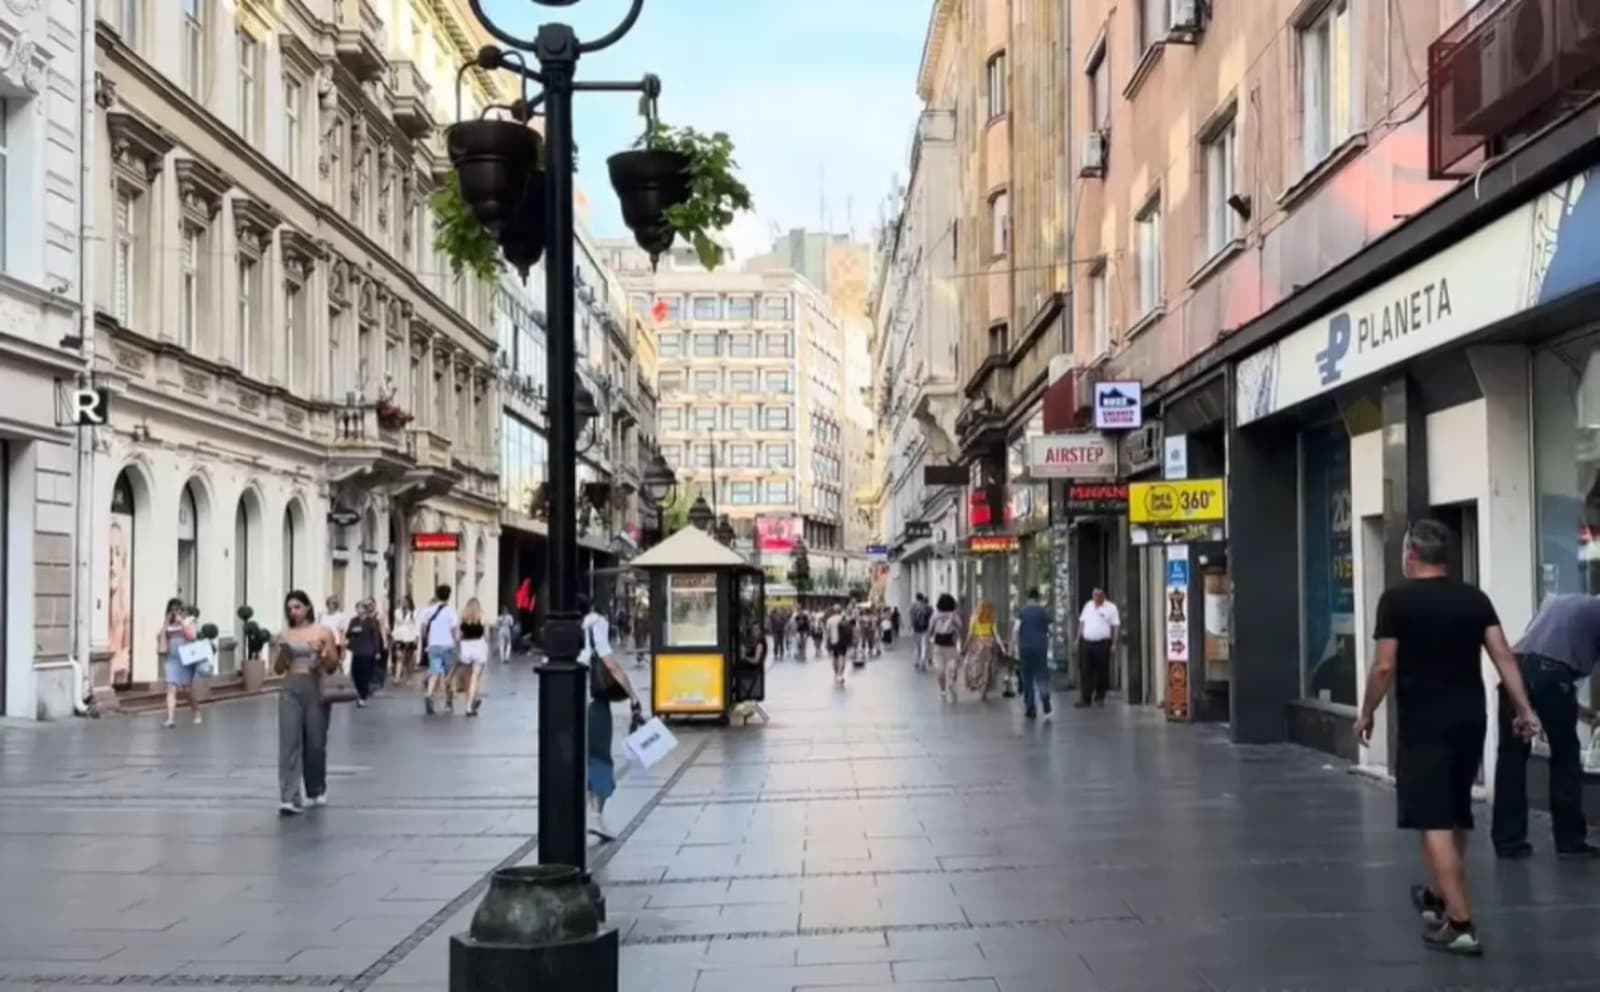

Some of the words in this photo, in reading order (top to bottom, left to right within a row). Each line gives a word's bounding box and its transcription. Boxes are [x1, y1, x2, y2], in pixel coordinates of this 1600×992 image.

[1357, 277, 1452, 354] PLANETA
[73, 389, 103, 422] R
[1045, 447, 1104, 464] AIRSTEP
